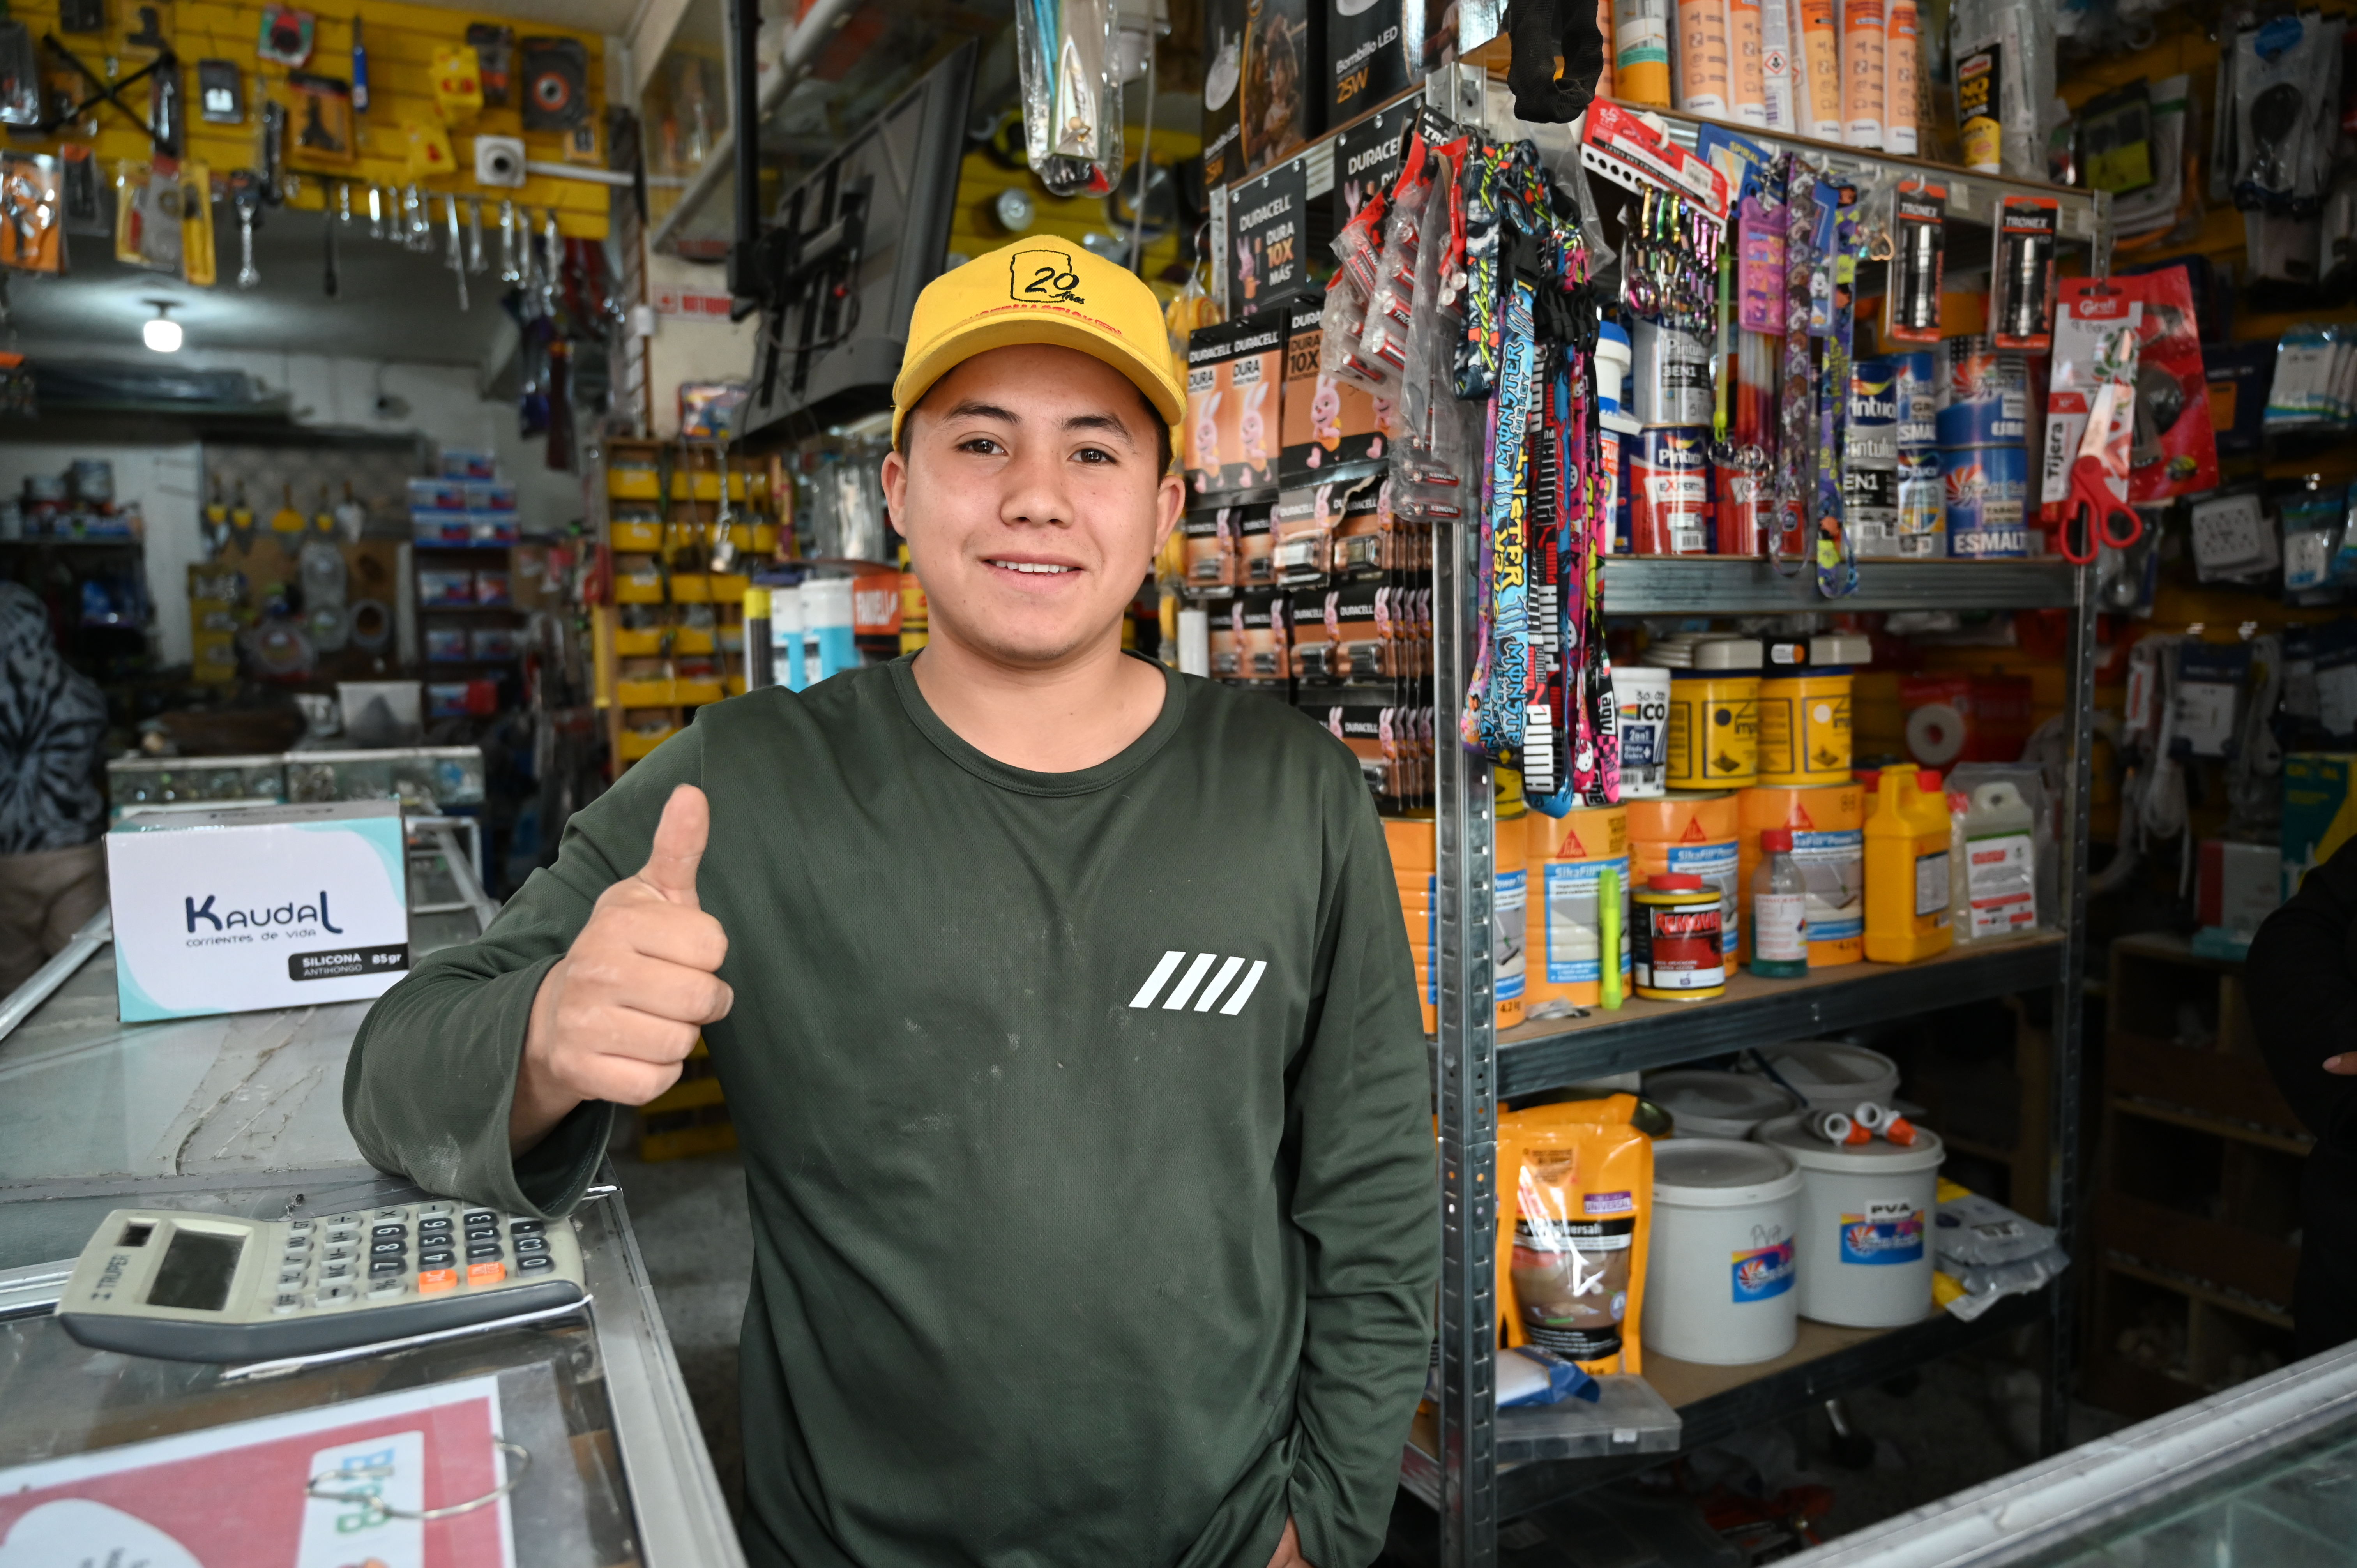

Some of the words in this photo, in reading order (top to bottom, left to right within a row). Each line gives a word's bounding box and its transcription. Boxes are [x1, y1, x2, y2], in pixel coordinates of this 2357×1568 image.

[1336, 40, 1376, 74] Bombillo
[1377, 26, 1398, 48] LED
[1424, 125, 1449, 146] TRO
[1348, 136, 1401, 175] DURACE
[1239, 194, 1292, 232] DURACELL
[1901, 202, 1938, 218] TRONEX
[2005, 216, 2048, 229] TRONEX
[1265, 221, 1295, 246] DURA
[1267, 237, 1295, 268] 10X
[1025, 267, 1080, 295] 20
[1048, 290, 1085, 305] Años
[1292, 309, 1323, 329] DURA
[1189, 341, 1232, 363] DURACELL
[1233, 332, 1279, 353] DURACELL
[1233, 359, 1260, 379] DURA
[1289, 350, 1320, 373] 10X
[1189, 369, 1214, 388] DURA
[1496, 343, 1525, 465] MONSTER
[1513, 371, 1530, 441] ENERGY
[2047, 422, 2063, 480] Tijera
[1844, 473, 1879, 491] EN1
[1279, 504, 1315, 517] DURACELL
[1347, 498, 1378, 510] URACELL
[1429, 503, 1458, 514] TRONEX
[1294, 608, 1325, 619] DURACELL
[1340, 605, 1374, 616] DURACELL
[1505, 644, 1527, 743] MONSTE
[1599, 697, 1613, 731] agv
[1345, 722, 1378, 733] DURACELL
[1523, 704, 1554, 793] PUMA
[185, 890, 343, 934] Kaudal
[186, 933, 254, 947] corrientes
[261, 931, 278, 941] de
[286, 928, 316, 938] vida
[302, 952, 362, 968] SILICONA
[371, 952, 402, 966] 85gr
[303, 963, 363, 977] ANTIHONGO
[1871, 1202, 1910, 1214] PVA
[423, 1236, 447, 1245] 5
[470, 1229, 494, 1238] 2
[375, 1243, 400, 1251] 8
[518, 1238, 542, 1251] 00
[374, 1262, 399, 1270] 7
[522, 1258, 547, 1267] 0
